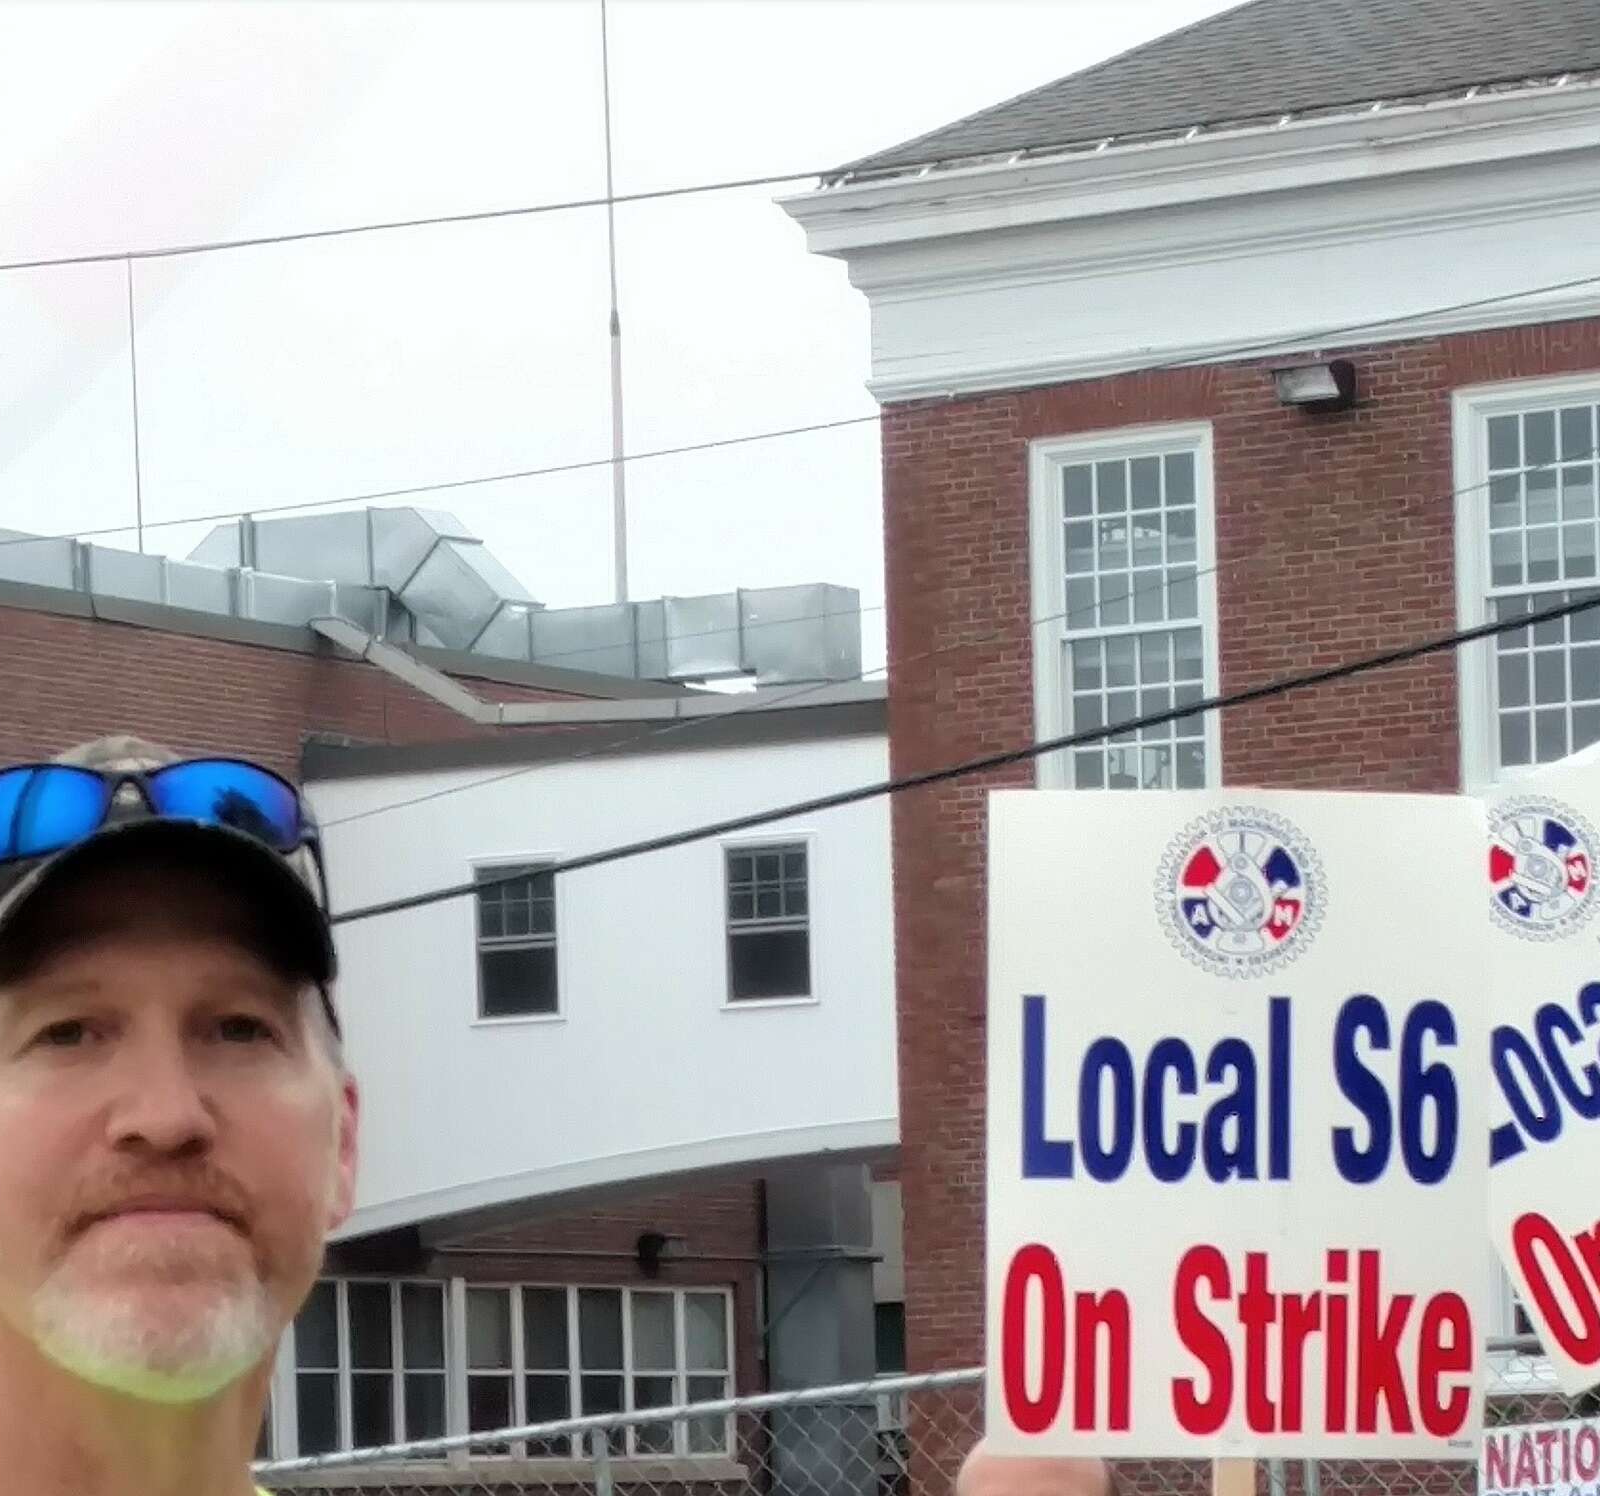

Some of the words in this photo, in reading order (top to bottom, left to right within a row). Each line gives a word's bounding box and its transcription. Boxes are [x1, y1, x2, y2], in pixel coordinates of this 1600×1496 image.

[1021, 994, 1291, 1182] Local
[1331, 993, 1459, 1185] S6
[1000, 1243, 1133, 1437] On
[1170, 1243, 1474, 1438] Strike
